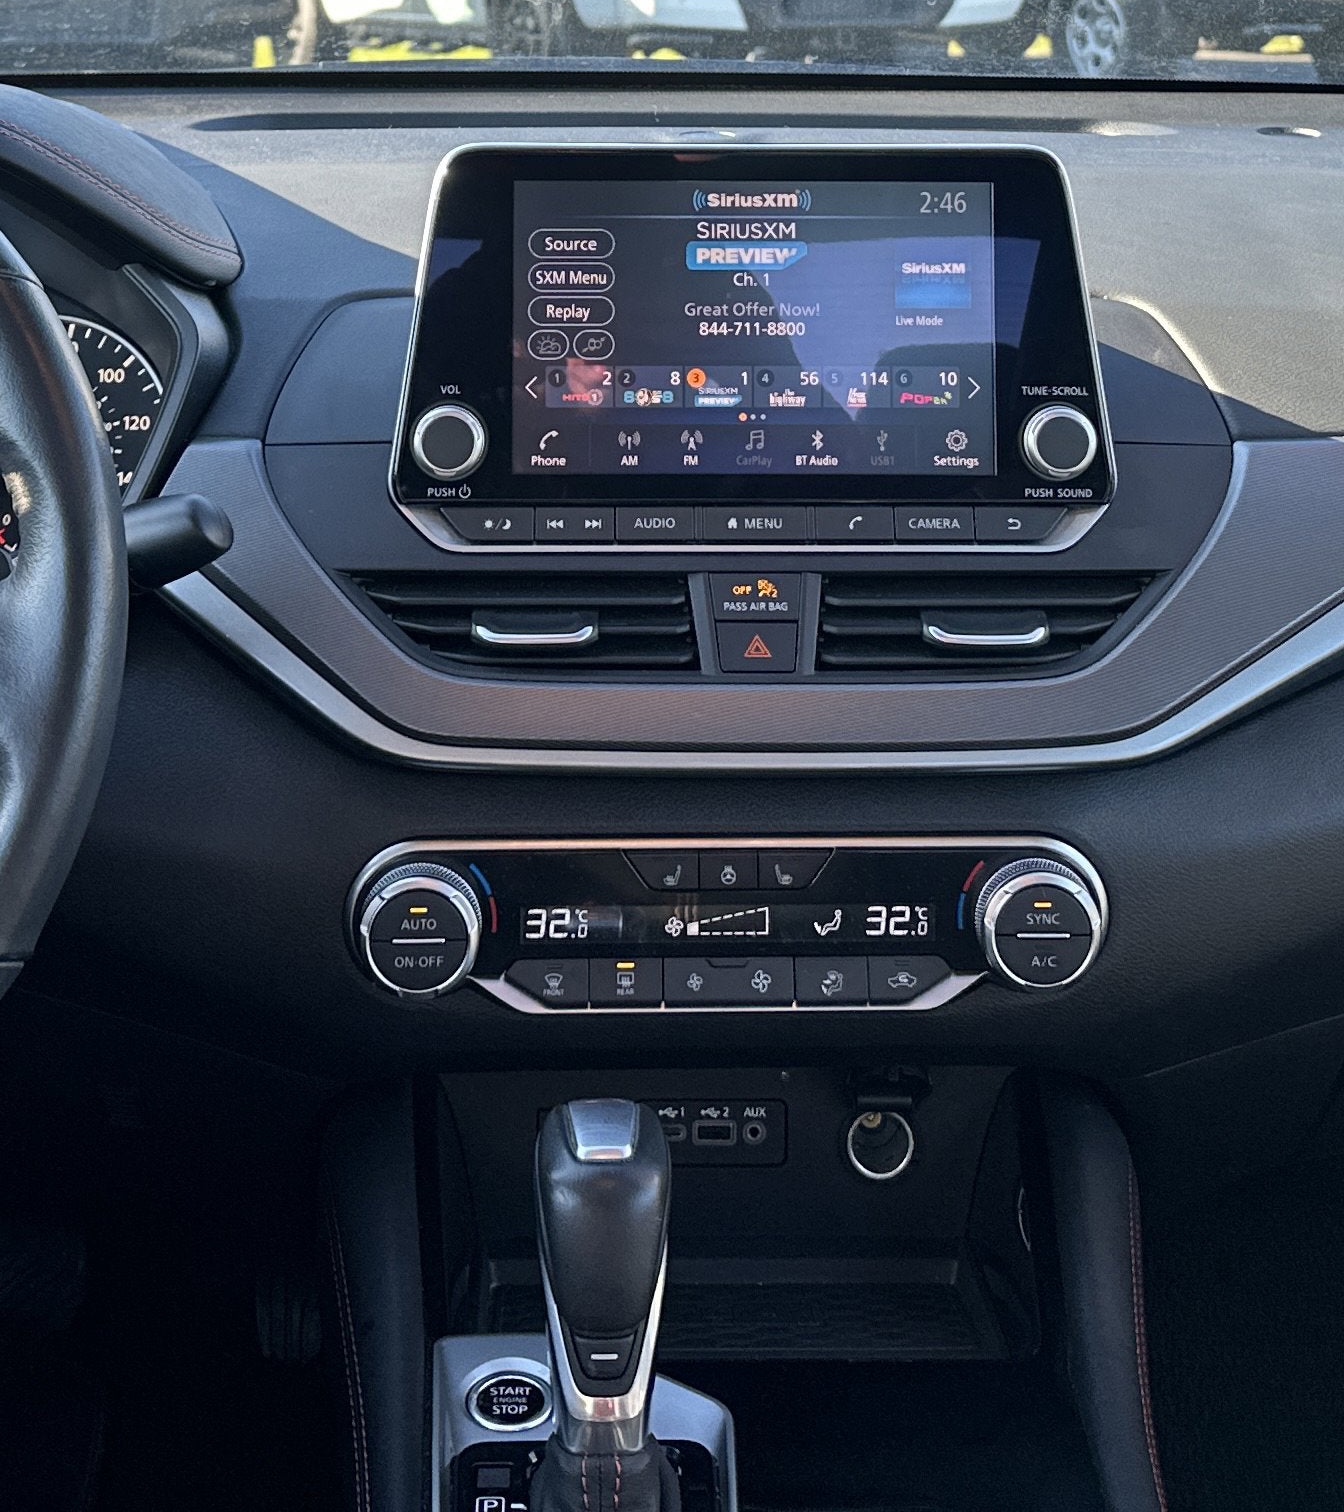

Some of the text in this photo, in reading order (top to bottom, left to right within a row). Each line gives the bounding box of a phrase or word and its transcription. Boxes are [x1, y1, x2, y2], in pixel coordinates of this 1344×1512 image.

[919, 191, 967, 214] 2:46
[696, 221, 797, 239] SIRIUSXM
[544, 237, 597, 251] Source
[696, 247, 798, 264] PREVIEW
[901, 262, 965, 274] SiriusXM
[535, 271, 607, 285] SXM Menu
[733, 272, 770, 287] Ch. 1
[546, 304, 591, 322] Replay
[684, 302, 820, 317] Great Offer Now!
[896, 315, 943, 326] Live Mode
[698, 321, 805, 336] 844-711-8800
[97, 368, 126, 383] 100
[554, 371, 612, 386] 1 2
[623, 371, 681, 385] 2 8
[693, 371, 748, 385] 3 1
[761, 371, 819, 386] 4 56
[831, 371, 888, 386] 5 114
[900, 371, 958, 386] 6 10
[440, 385, 461, 395] VOL
[698, 397, 736, 405] PREVIEW
[122, 415, 151, 431] 120
[530, 455, 567, 467] Phone
[620, 456, 639, 466] AM
[683, 456, 699, 466] FM
[736, 456, 772, 468] CarPlay
[795, 456, 839, 466] BT Audio
[933, 455, 980, 469] Settings
[427, 487, 456, 497] PUSH
[1024, 488, 1093, 498] PUSH SOUND
[634, 518, 676, 530] AUDIO
[744, 518, 783, 530] MENU
[908, 518, 961, 530] CAMERA
[732, 585, 751, 595] OFF
[724, 602, 788, 611] PASS AIR BAG
[401, 919, 437, 930] AUTO
[1026, 913, 1060, 925] SYNC
[1031, 956, 1057, 968] A/C
[616, 987, 634, 995] REAR
[680, 1107, 685, 1117] 1
[723, 1107, 729, 1117] 2
[744, 1107, 766, 1118] AUX
[490, 1387, 532, 1396] START
[492, 1405, 528, 1414] STOP
[484, 1500, 498, 1512] P
